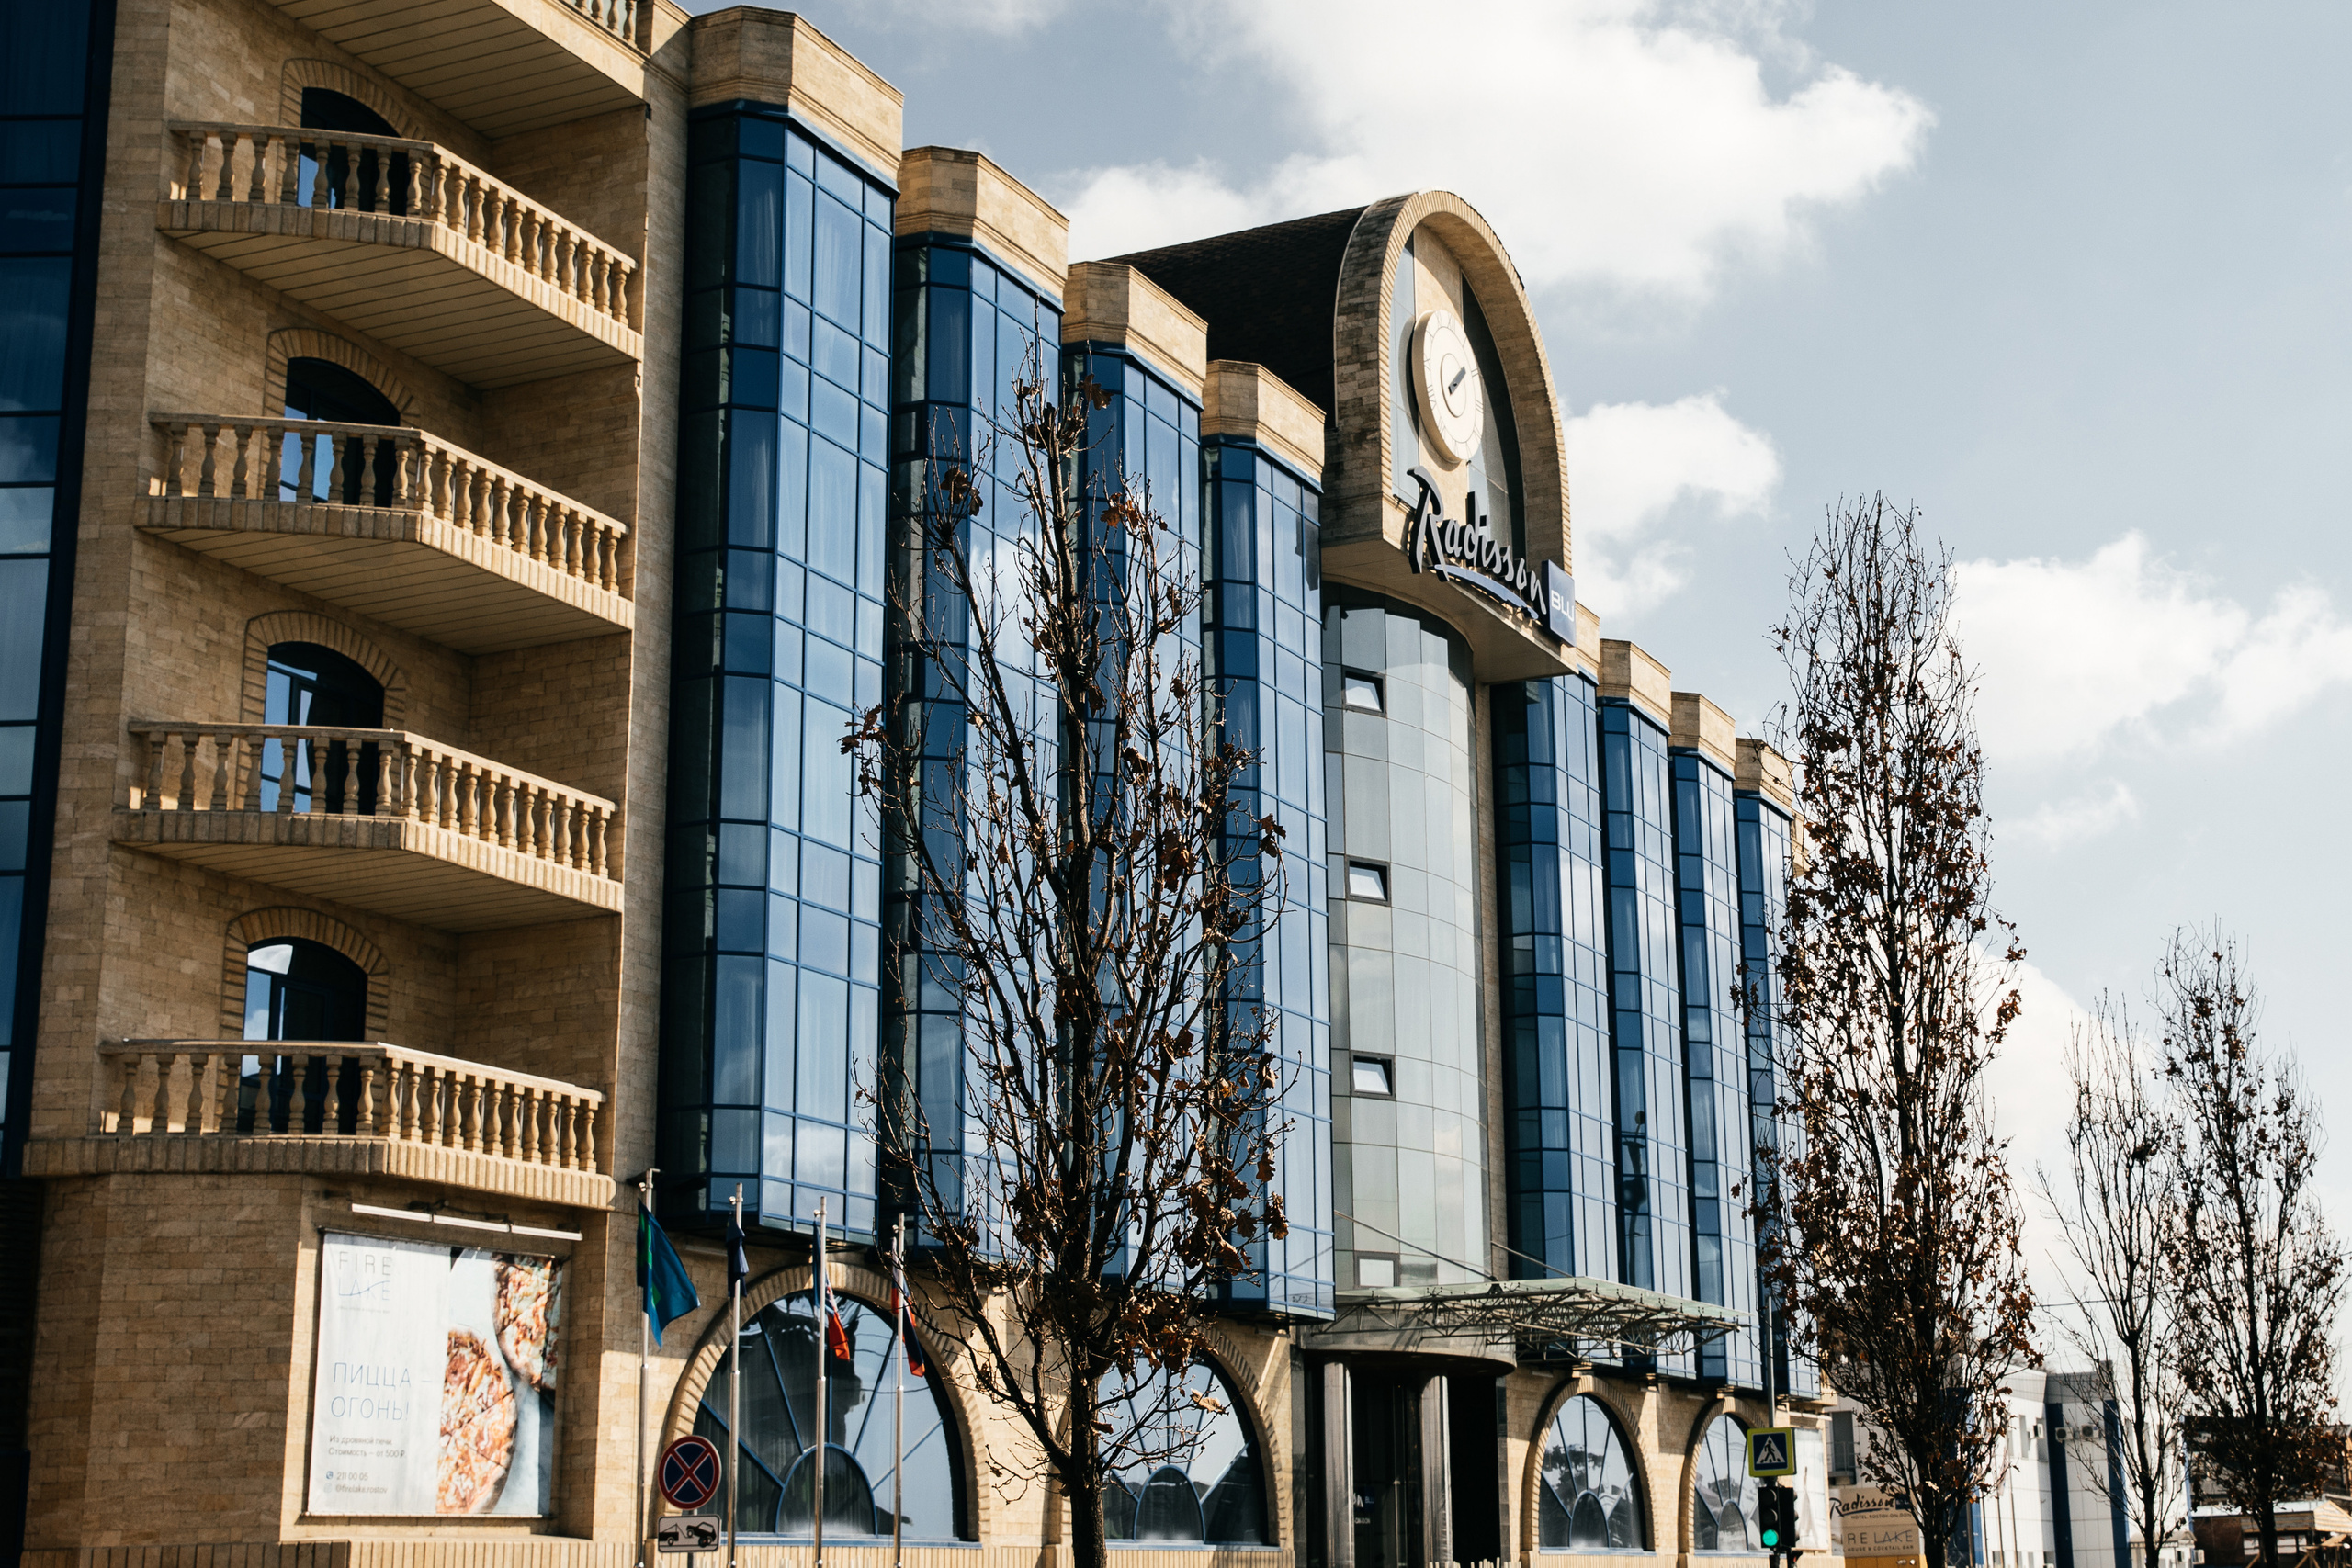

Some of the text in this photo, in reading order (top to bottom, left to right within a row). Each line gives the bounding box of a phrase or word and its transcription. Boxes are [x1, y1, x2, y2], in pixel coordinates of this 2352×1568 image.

[1407, 466, 1575, 623] Radisson BLU
[339, 1251, 392, 1276] FIRE
[338, 1278, 390, 1300] LAKE
[333, 1362, 411, 1390] ПИЦЦА
[331, 1396, 409, 1421] ОГОНЬ!
[329, 1435, 339, 1443] Из
[328, 1447, 368, 1457] Стоимость
[336, 1472, 368, 1481] 211 00 05
[1829, 1493, 1895, 1520] Radisson
[1874, 1529, 1913, 1544] LAKE
